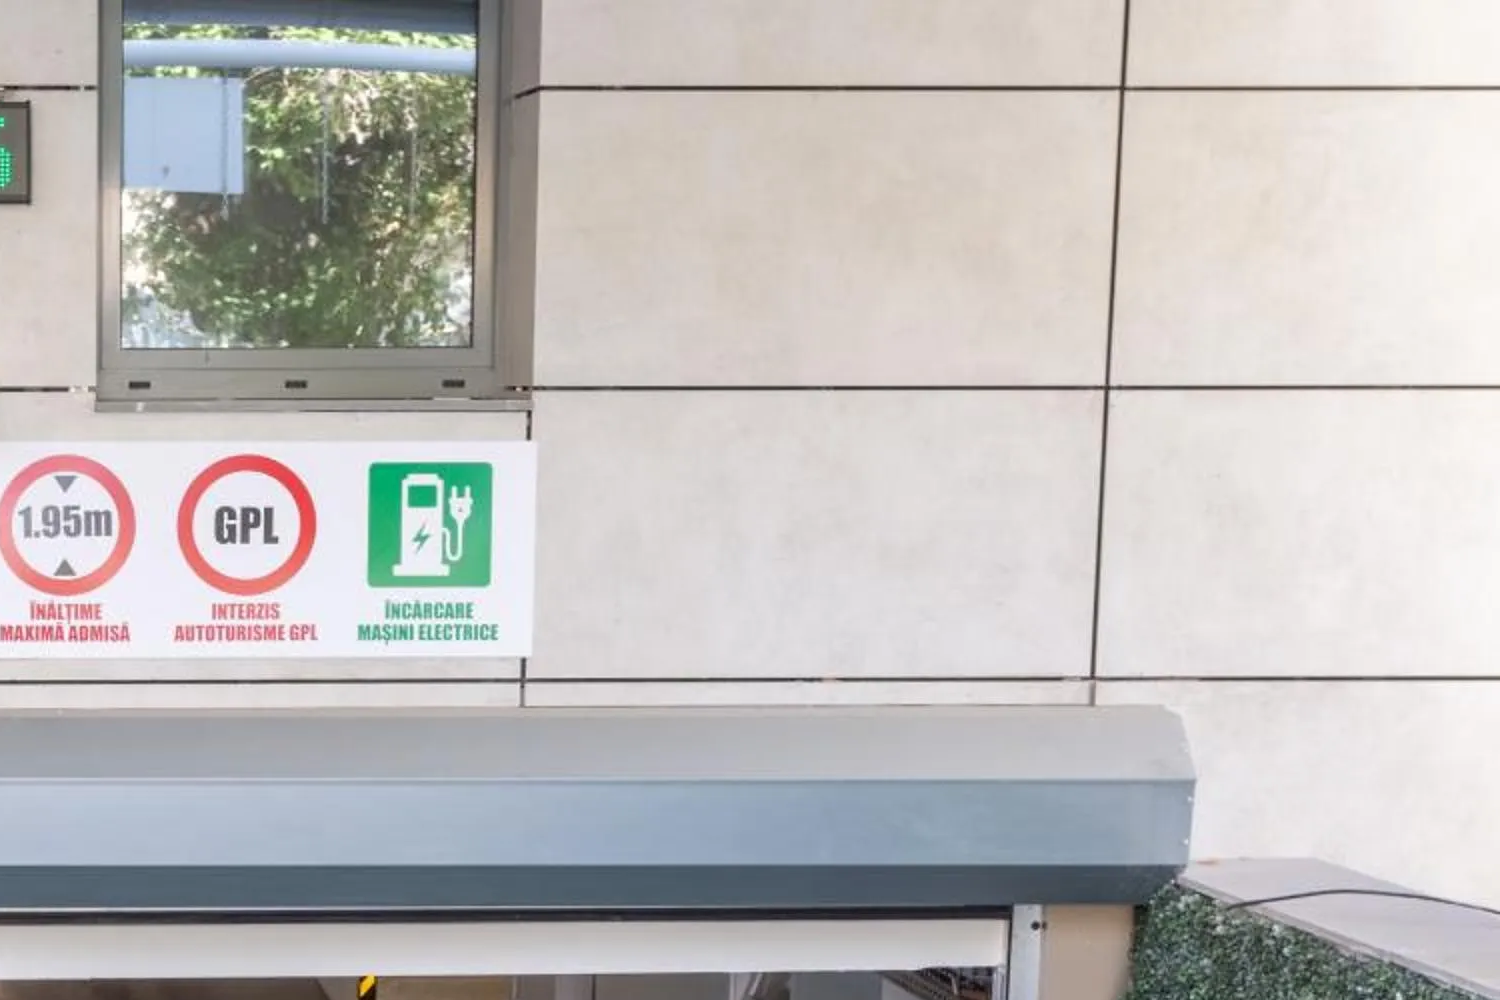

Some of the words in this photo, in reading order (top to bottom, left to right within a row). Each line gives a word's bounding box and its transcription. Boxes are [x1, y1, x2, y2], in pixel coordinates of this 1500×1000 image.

[17, 505, 113, 540] 1.95m
[213, 506, 279, 545] GPL
[211, 602, 281, 620] INTERZIS
[174, 623, 285, 642] AUTOTURISME
[289, 623, 319, 642] GPL
[418, 623, 499, 641] ELECTRICE
